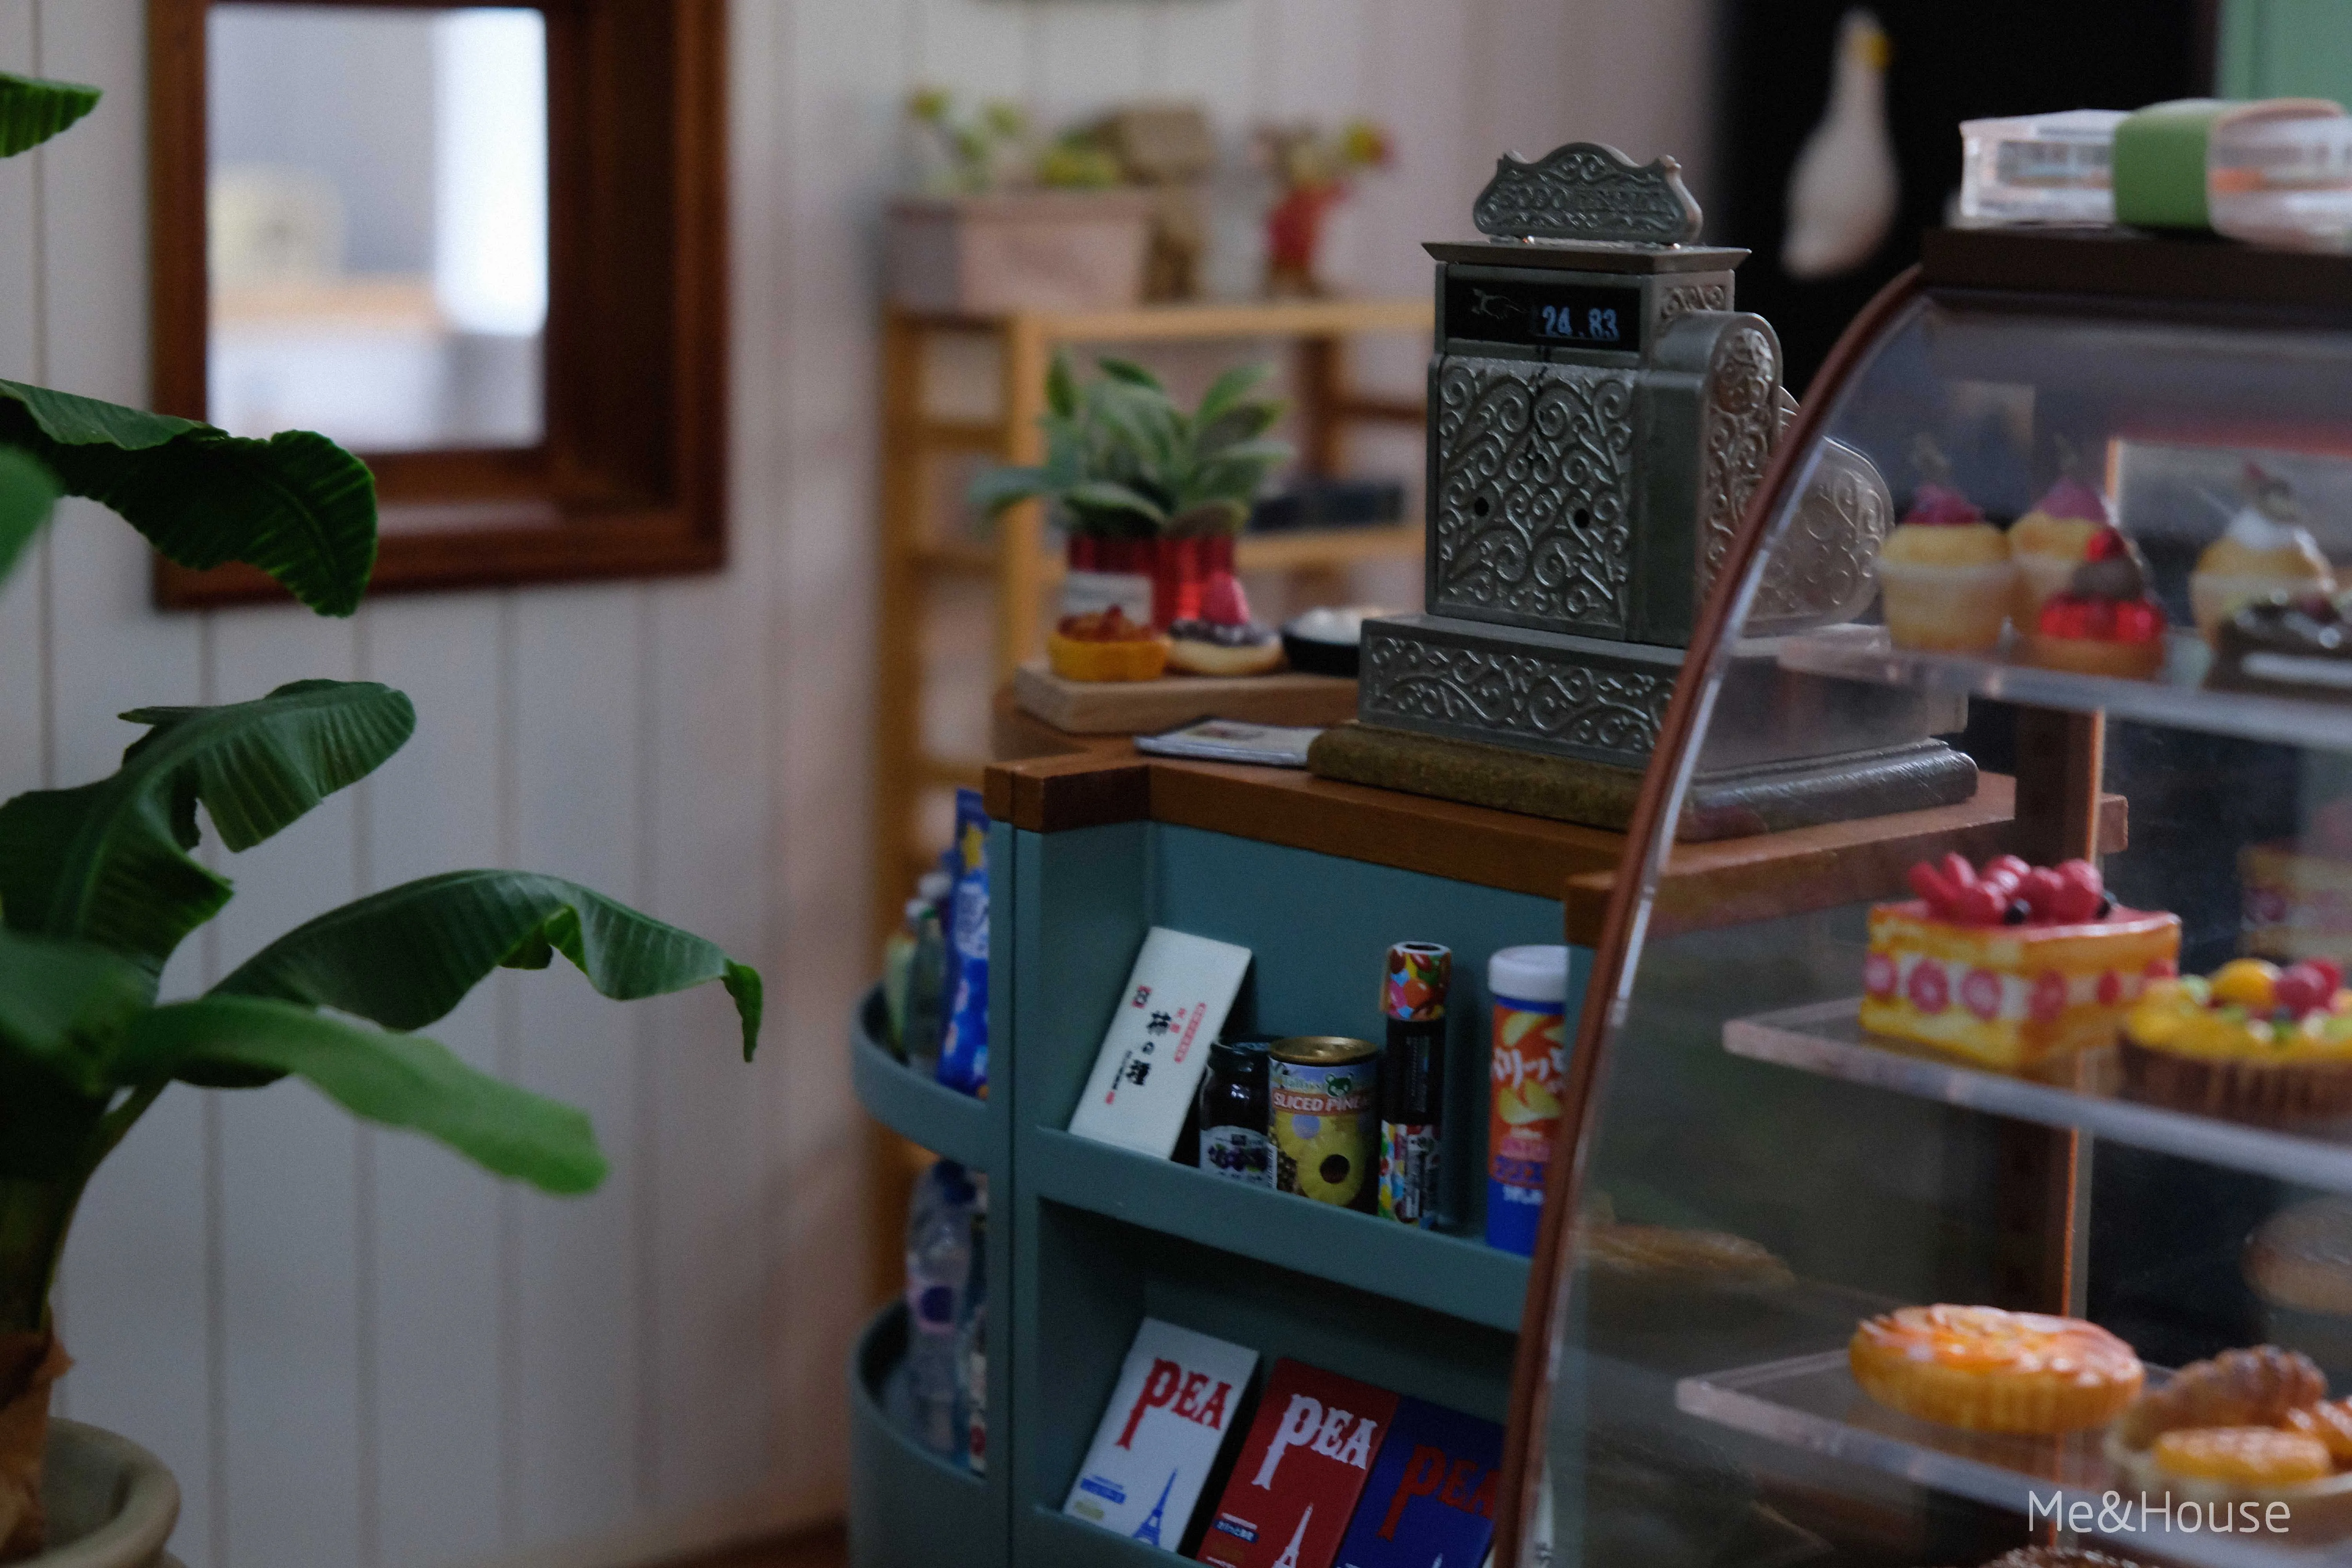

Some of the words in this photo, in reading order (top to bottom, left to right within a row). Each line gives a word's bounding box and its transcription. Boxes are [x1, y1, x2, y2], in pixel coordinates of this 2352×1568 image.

[1274, 1092, 1323, 1112] SLICED
[1116, 1357, 1231, 1450] PEA
[1251, 1393, 1377, 1491] PEA
